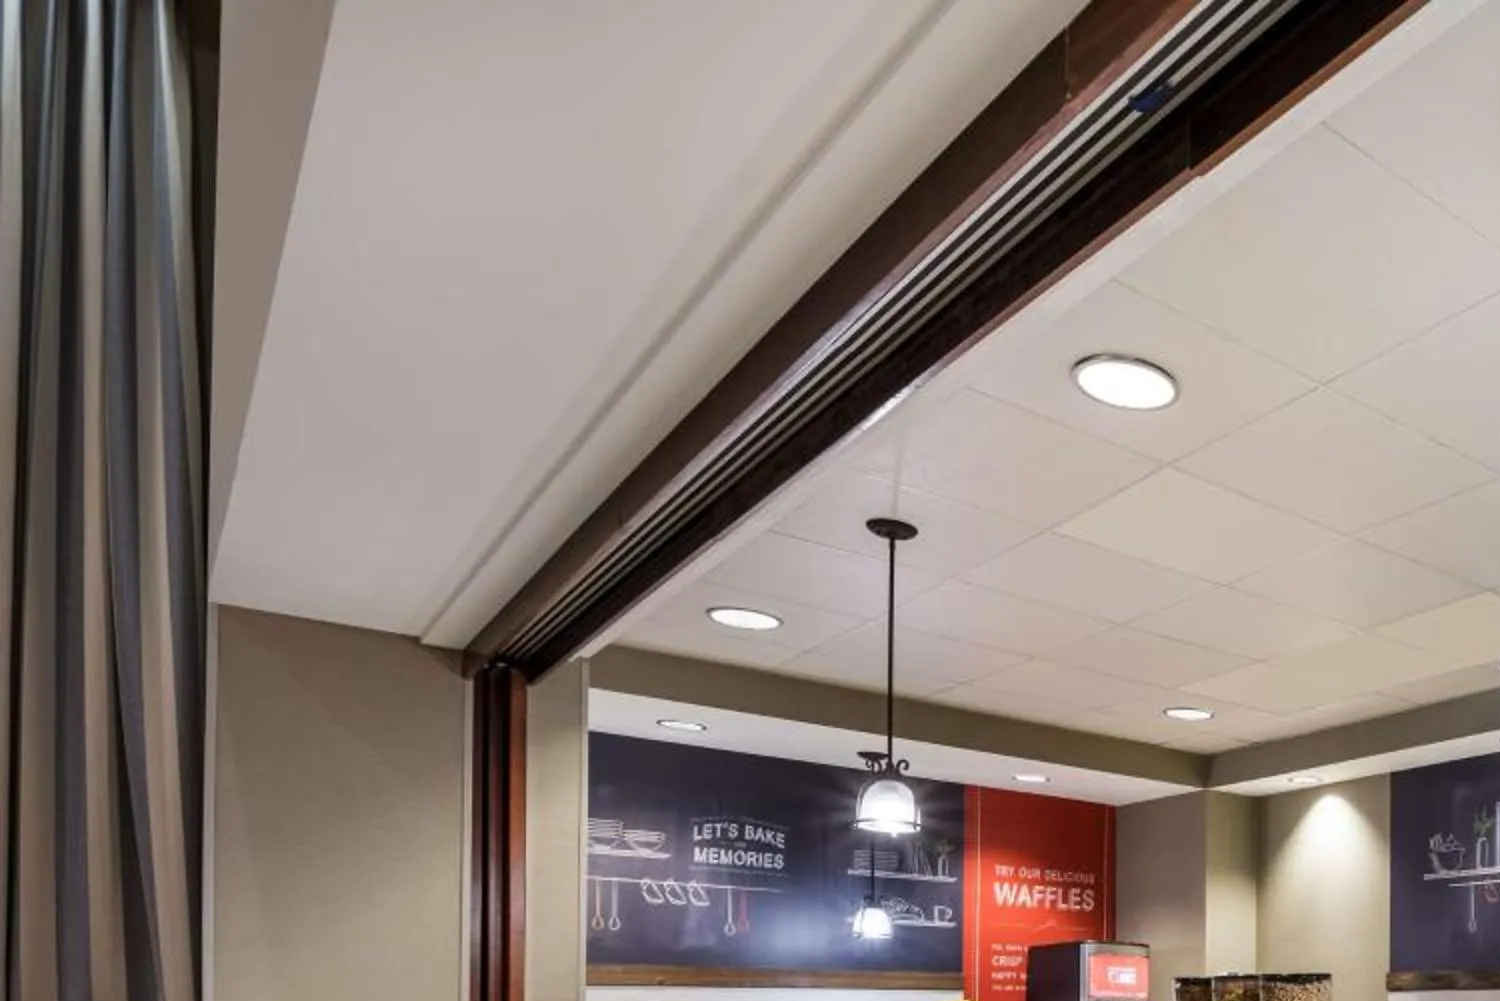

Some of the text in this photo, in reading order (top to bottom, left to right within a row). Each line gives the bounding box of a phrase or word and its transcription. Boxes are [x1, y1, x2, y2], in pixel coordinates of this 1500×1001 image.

[692, 822, 785, 849] LET'S BAKE
[693, 846, 785, 870] MEMORIES
[994, 864, 1095, 884] TRY OUR DELICIOUS
[993, 881, 1096, 912] WAFFLES
